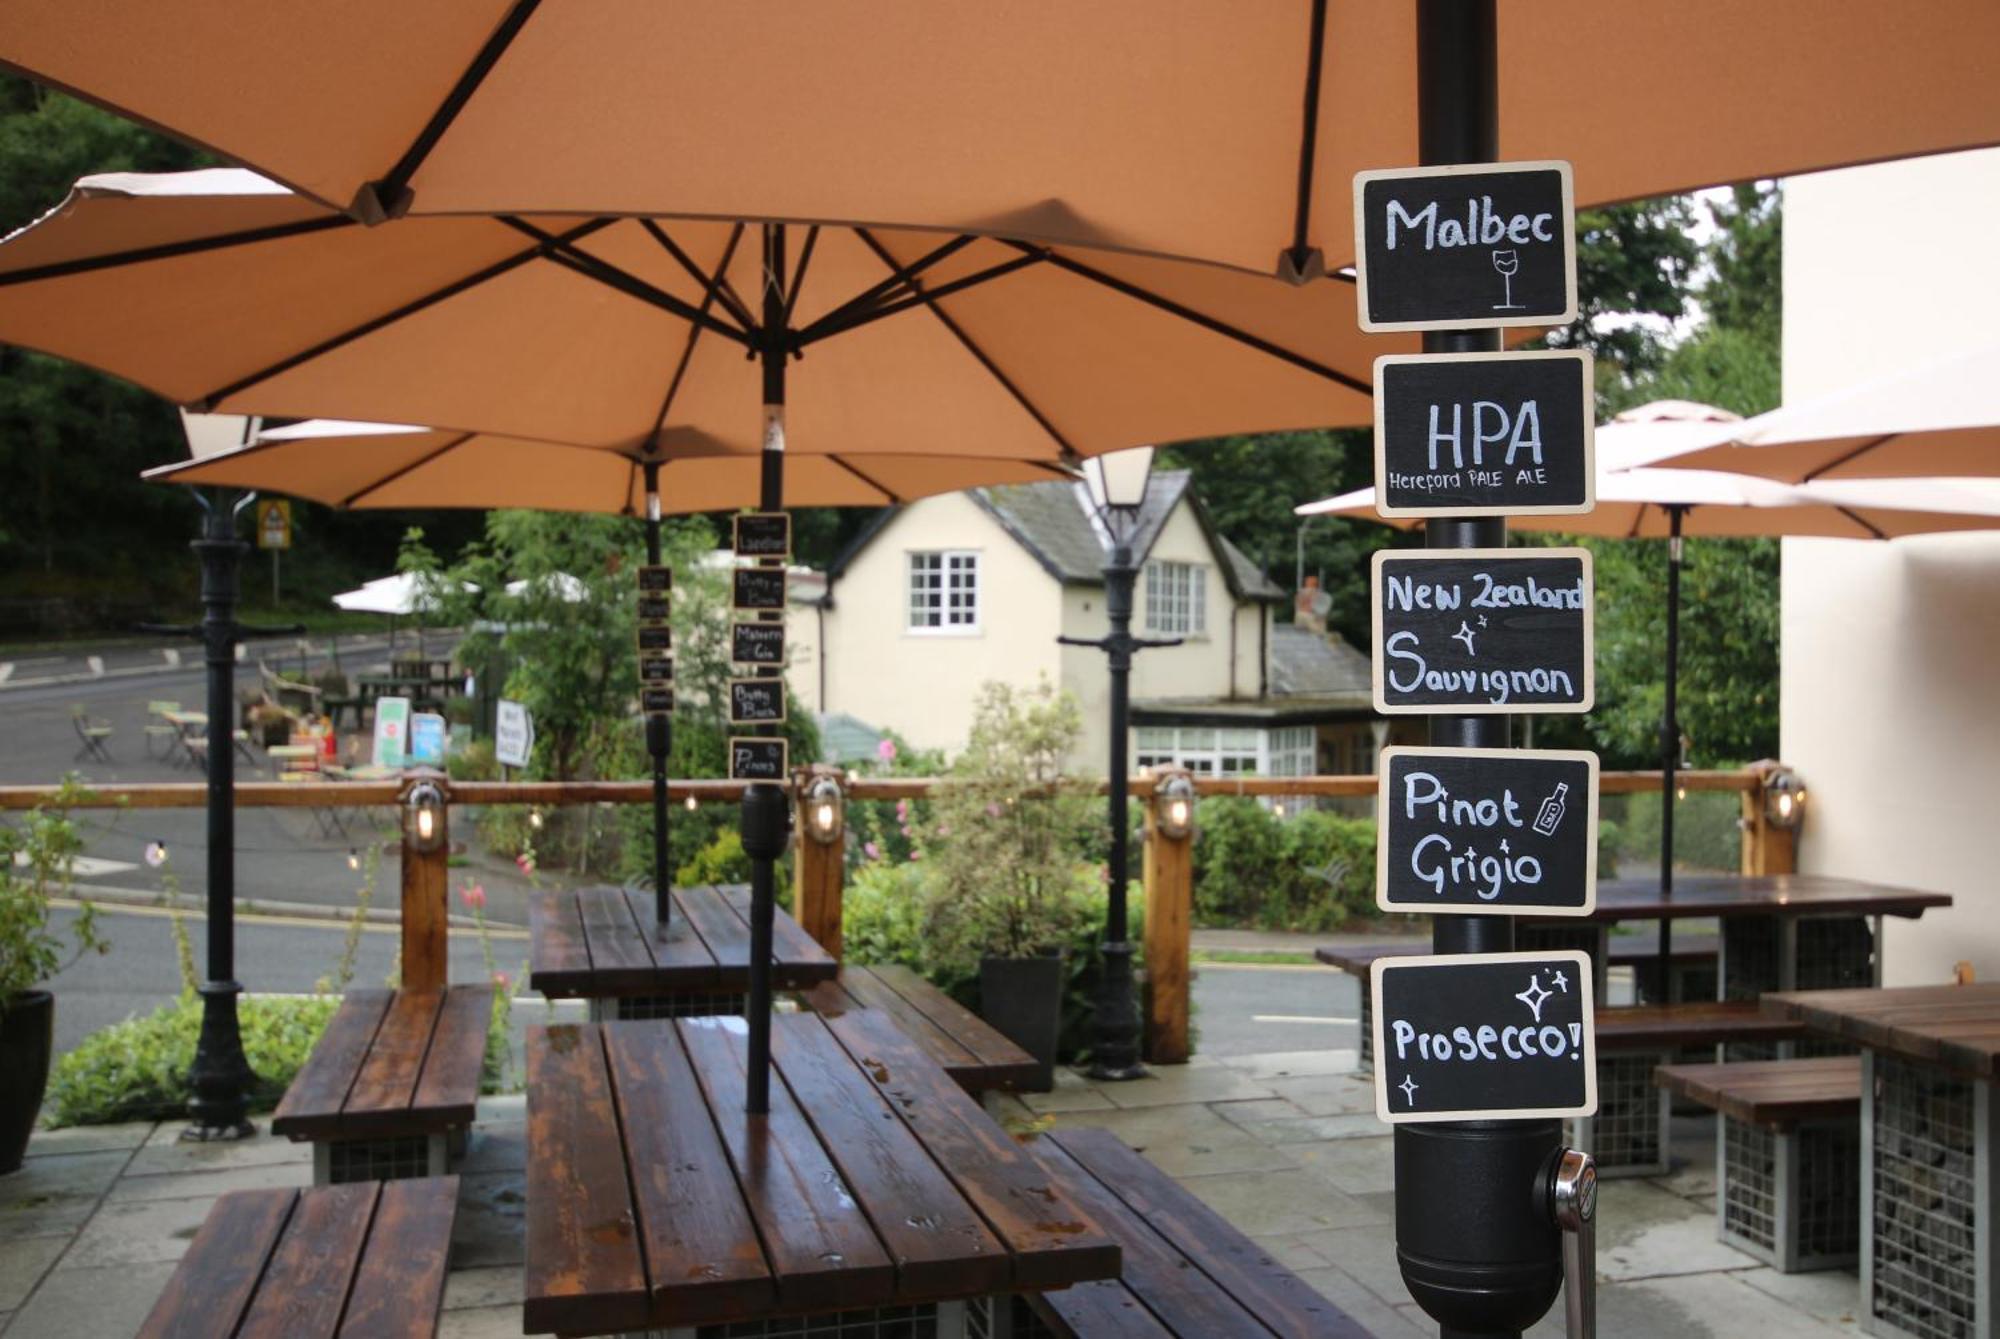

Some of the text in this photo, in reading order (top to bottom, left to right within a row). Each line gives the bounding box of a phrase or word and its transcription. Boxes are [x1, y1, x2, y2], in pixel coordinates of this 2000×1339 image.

[1386, 196, 1553, 250] Malbec
[1428, 400, 1543, 470] HPA
[1389, 468, 1548, 494] Hereford PALE ALE
[1387, 573, 1585, 611] New Zealand
[1385, 631, 1574, 705] Sauvignon
[1403, 771, 1524, 828] Pinot
[1411, 834, 1543, 899] Grigio
[1392, 1020, 1581, 1061] Prosecco!
